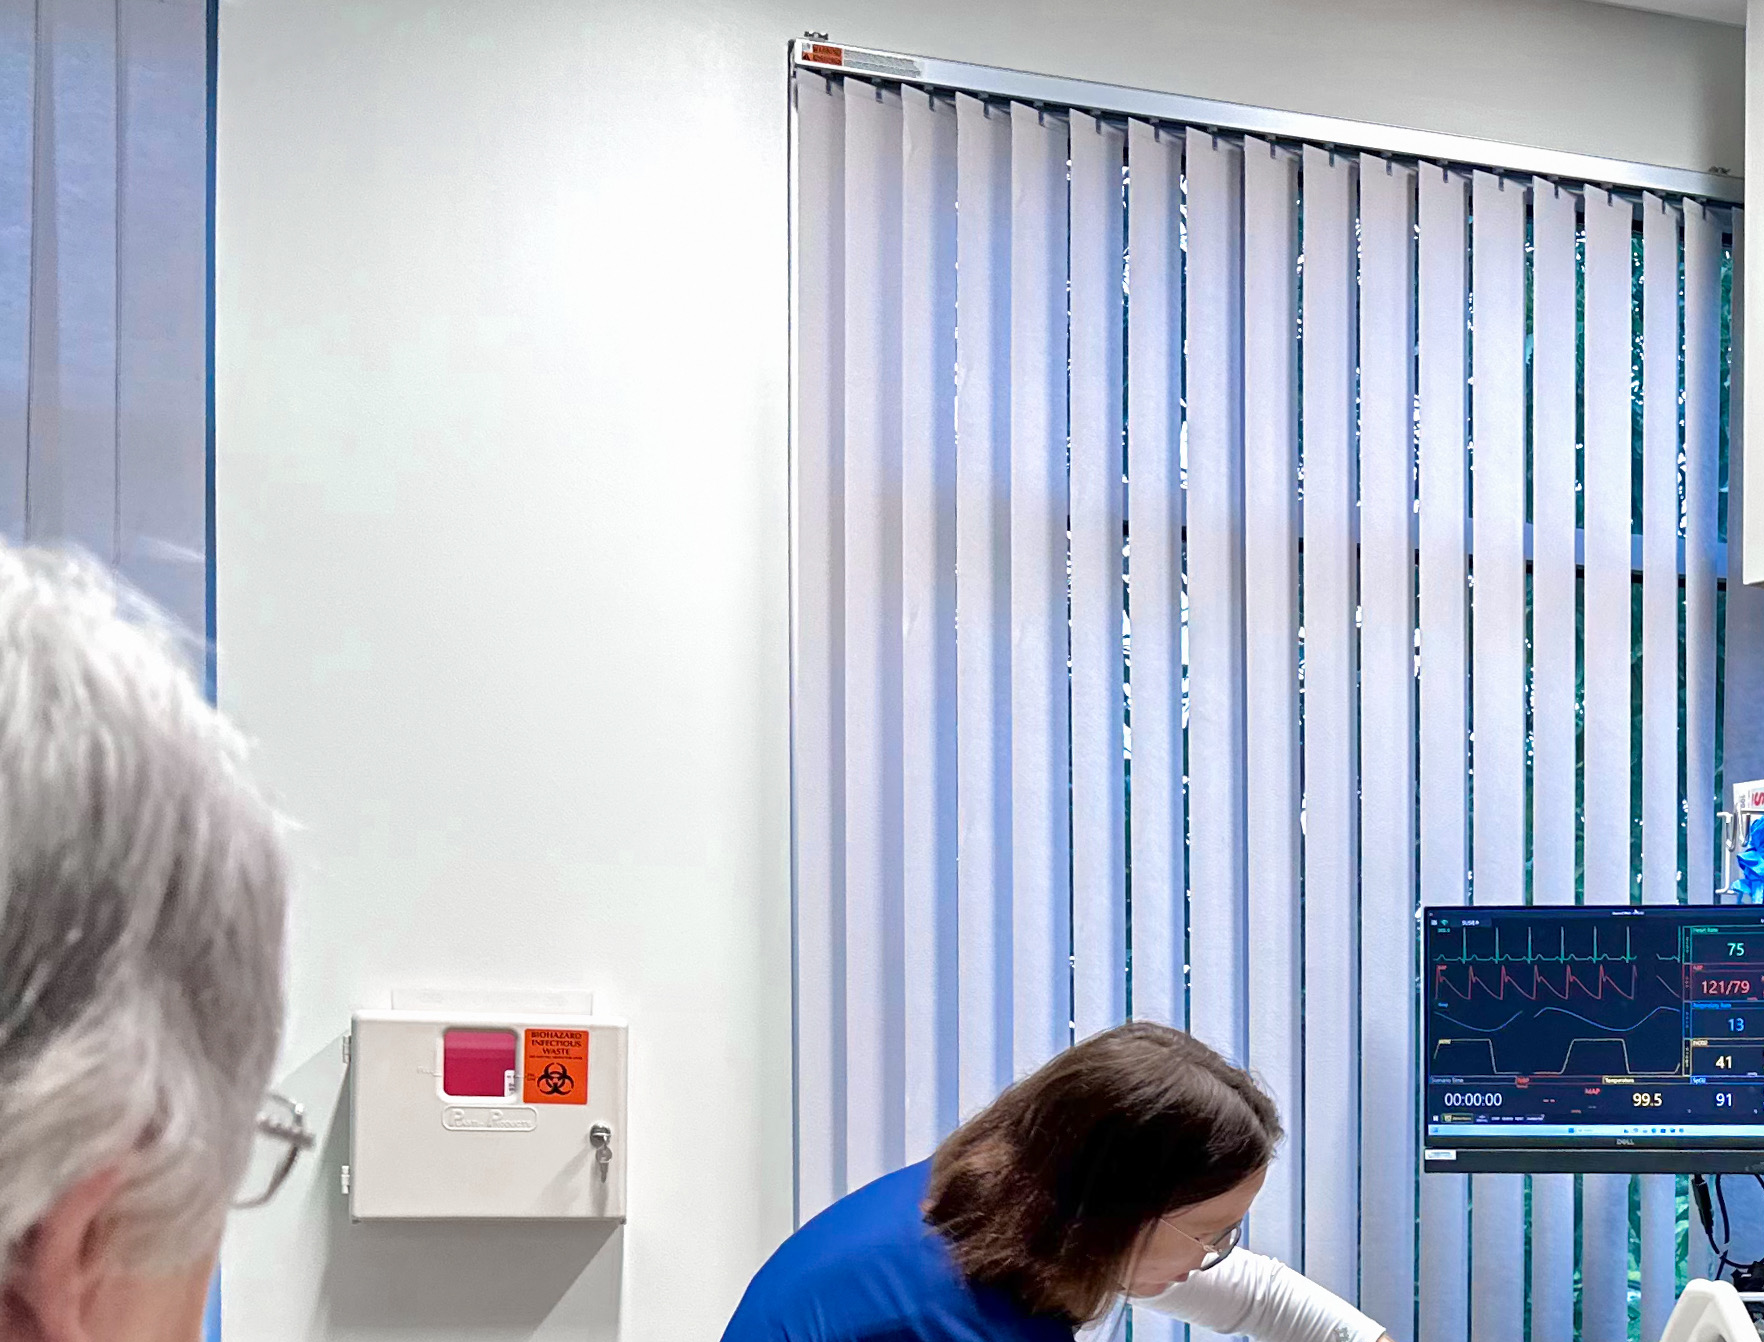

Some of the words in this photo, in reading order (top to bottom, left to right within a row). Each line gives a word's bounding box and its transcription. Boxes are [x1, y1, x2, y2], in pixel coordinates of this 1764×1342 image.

[1726, 942, 1745, 957] 75
[1701, 980, 1751, 995] 121/79
[1728, 1017, 1745, 1032] 13
[531, 1031, 583, 1040] BIOHAZARD
[531, 1039, 582, 1048] INFECTIOUS
[542, 1047, 571, 1056] WASTE
[1715, 1055, 1733, 1070] 41
[1444, 1092, 1503, 1107] 00:00:00
[1632, 1092, 1663, 1107] 99.5
[1715, 1092, 1733, 1107] 91
[1616, 1138, 1635, 1146] DELL
